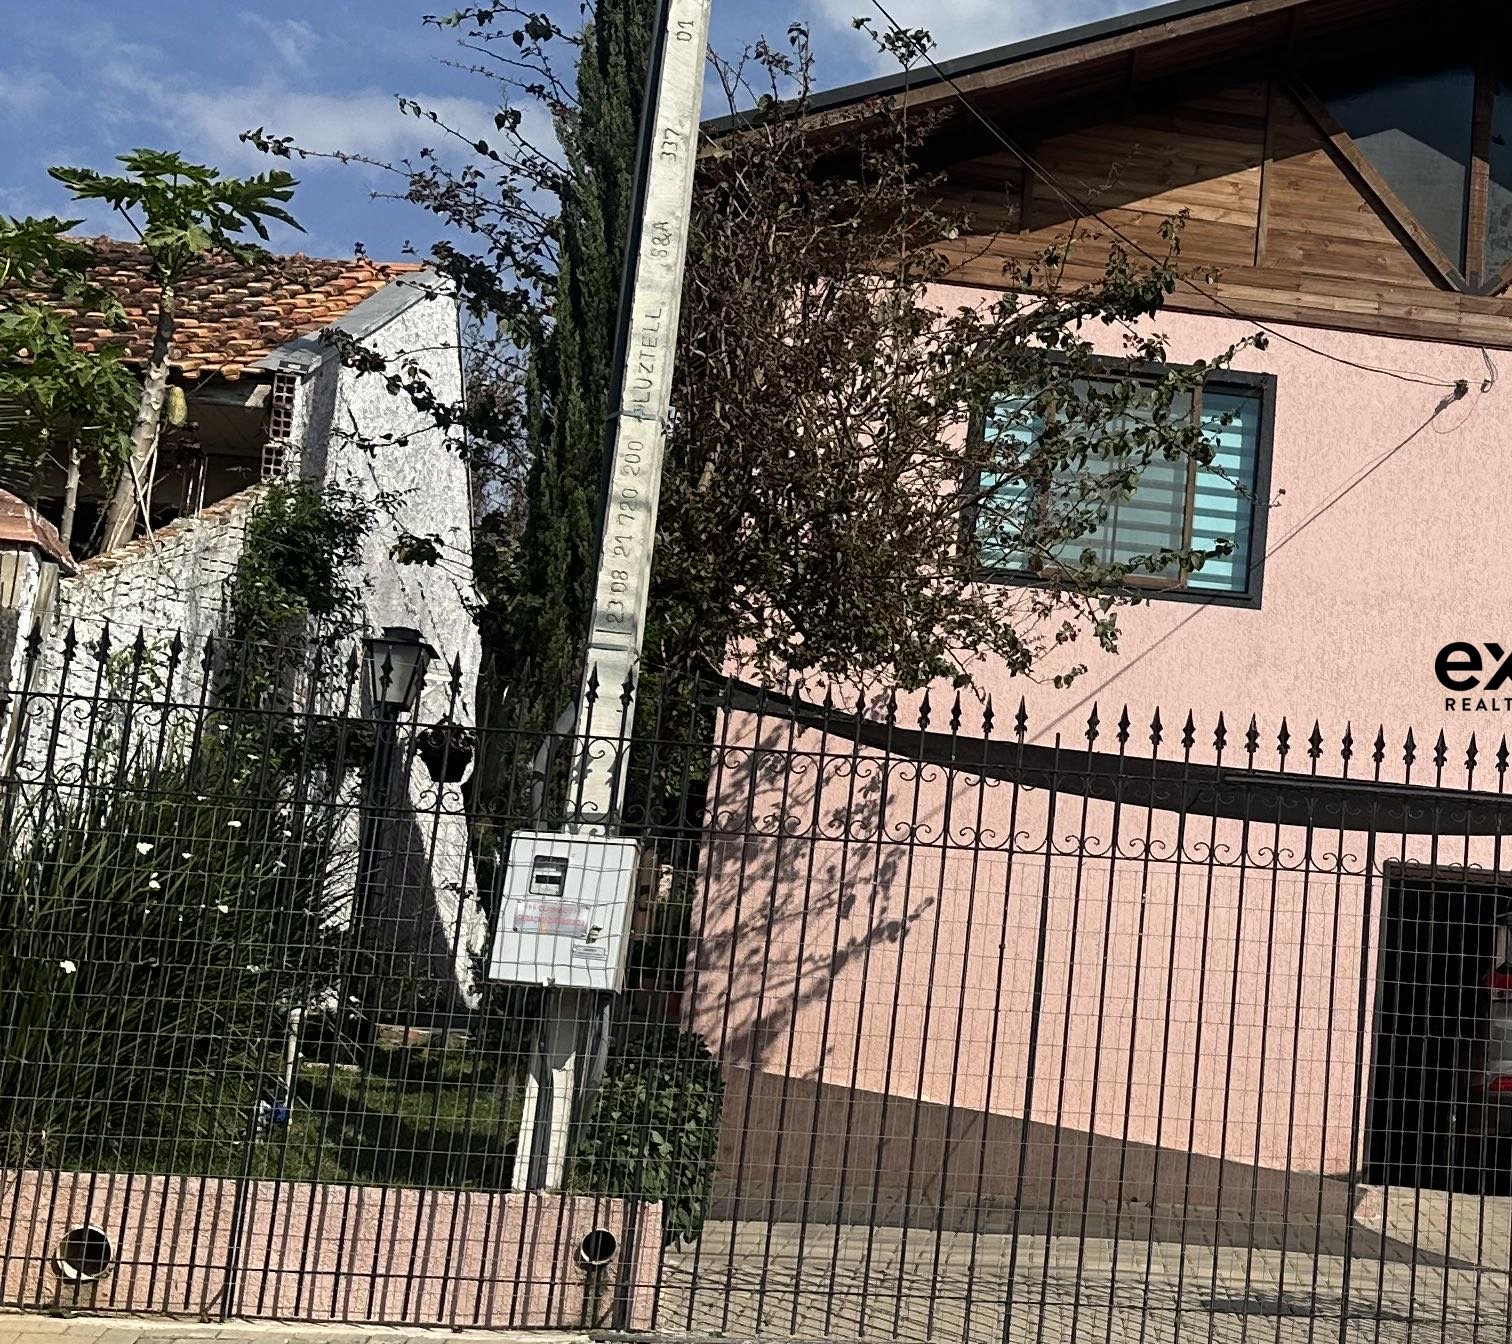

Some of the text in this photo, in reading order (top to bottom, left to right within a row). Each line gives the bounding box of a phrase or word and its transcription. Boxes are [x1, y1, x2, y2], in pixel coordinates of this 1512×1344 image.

[676, 20, 694, 42] 01
[660, 127, 680, 162] 337
[623, 441, 643, 476] 200
[618, 488, 638, 525] 720
[613, 535, 632, 557] 21
[611, 570, 628, 592] 08
[606, 601, 624, 623] 23
